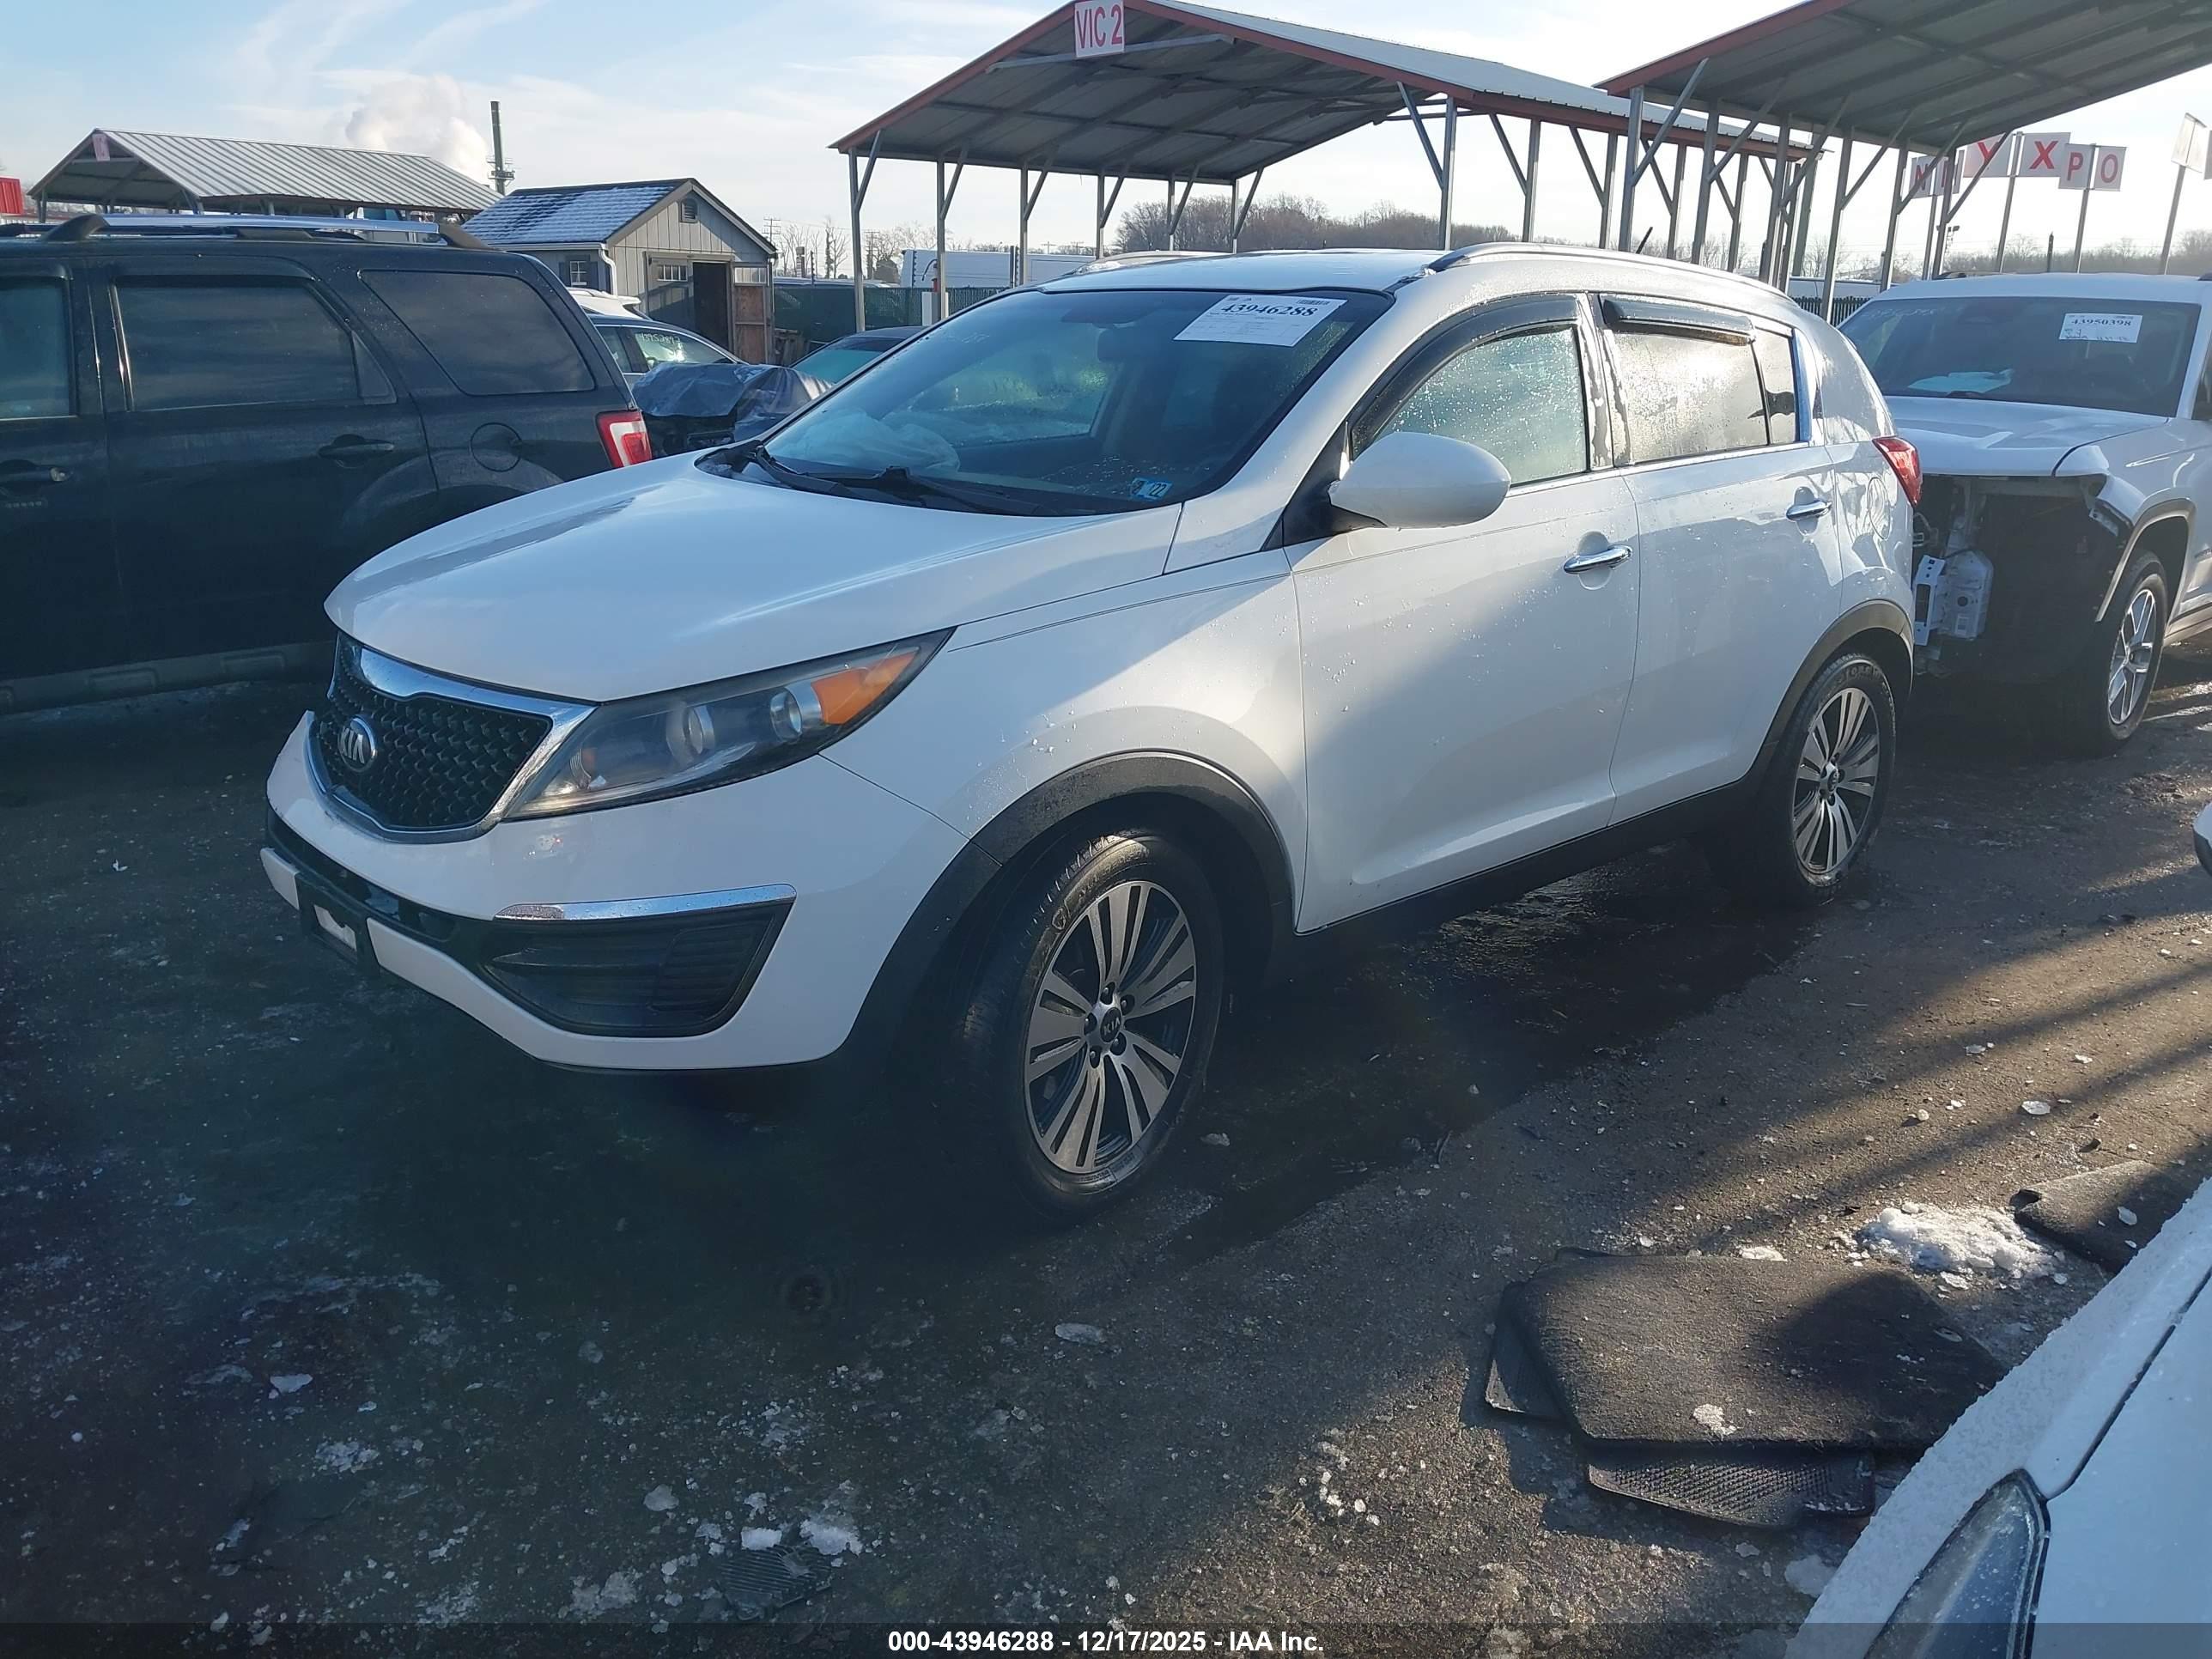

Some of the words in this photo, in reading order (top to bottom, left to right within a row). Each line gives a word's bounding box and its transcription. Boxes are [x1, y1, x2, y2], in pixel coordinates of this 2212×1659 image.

[1076, 6, 1106, 49] VIC
[1110, 4, 1123, 45] 2
[2029, 140, 2059, 170] X
[2066, 152, 2084, 181] P
[1221, 303, 1319, 317] 43946288
[2071, 318, 2132, 326] 43950398
[1148, 483, 1168, 497] 22
[339, 727, 365, 764] KIA
[1103, 1017, 1121, 1036] KIA
